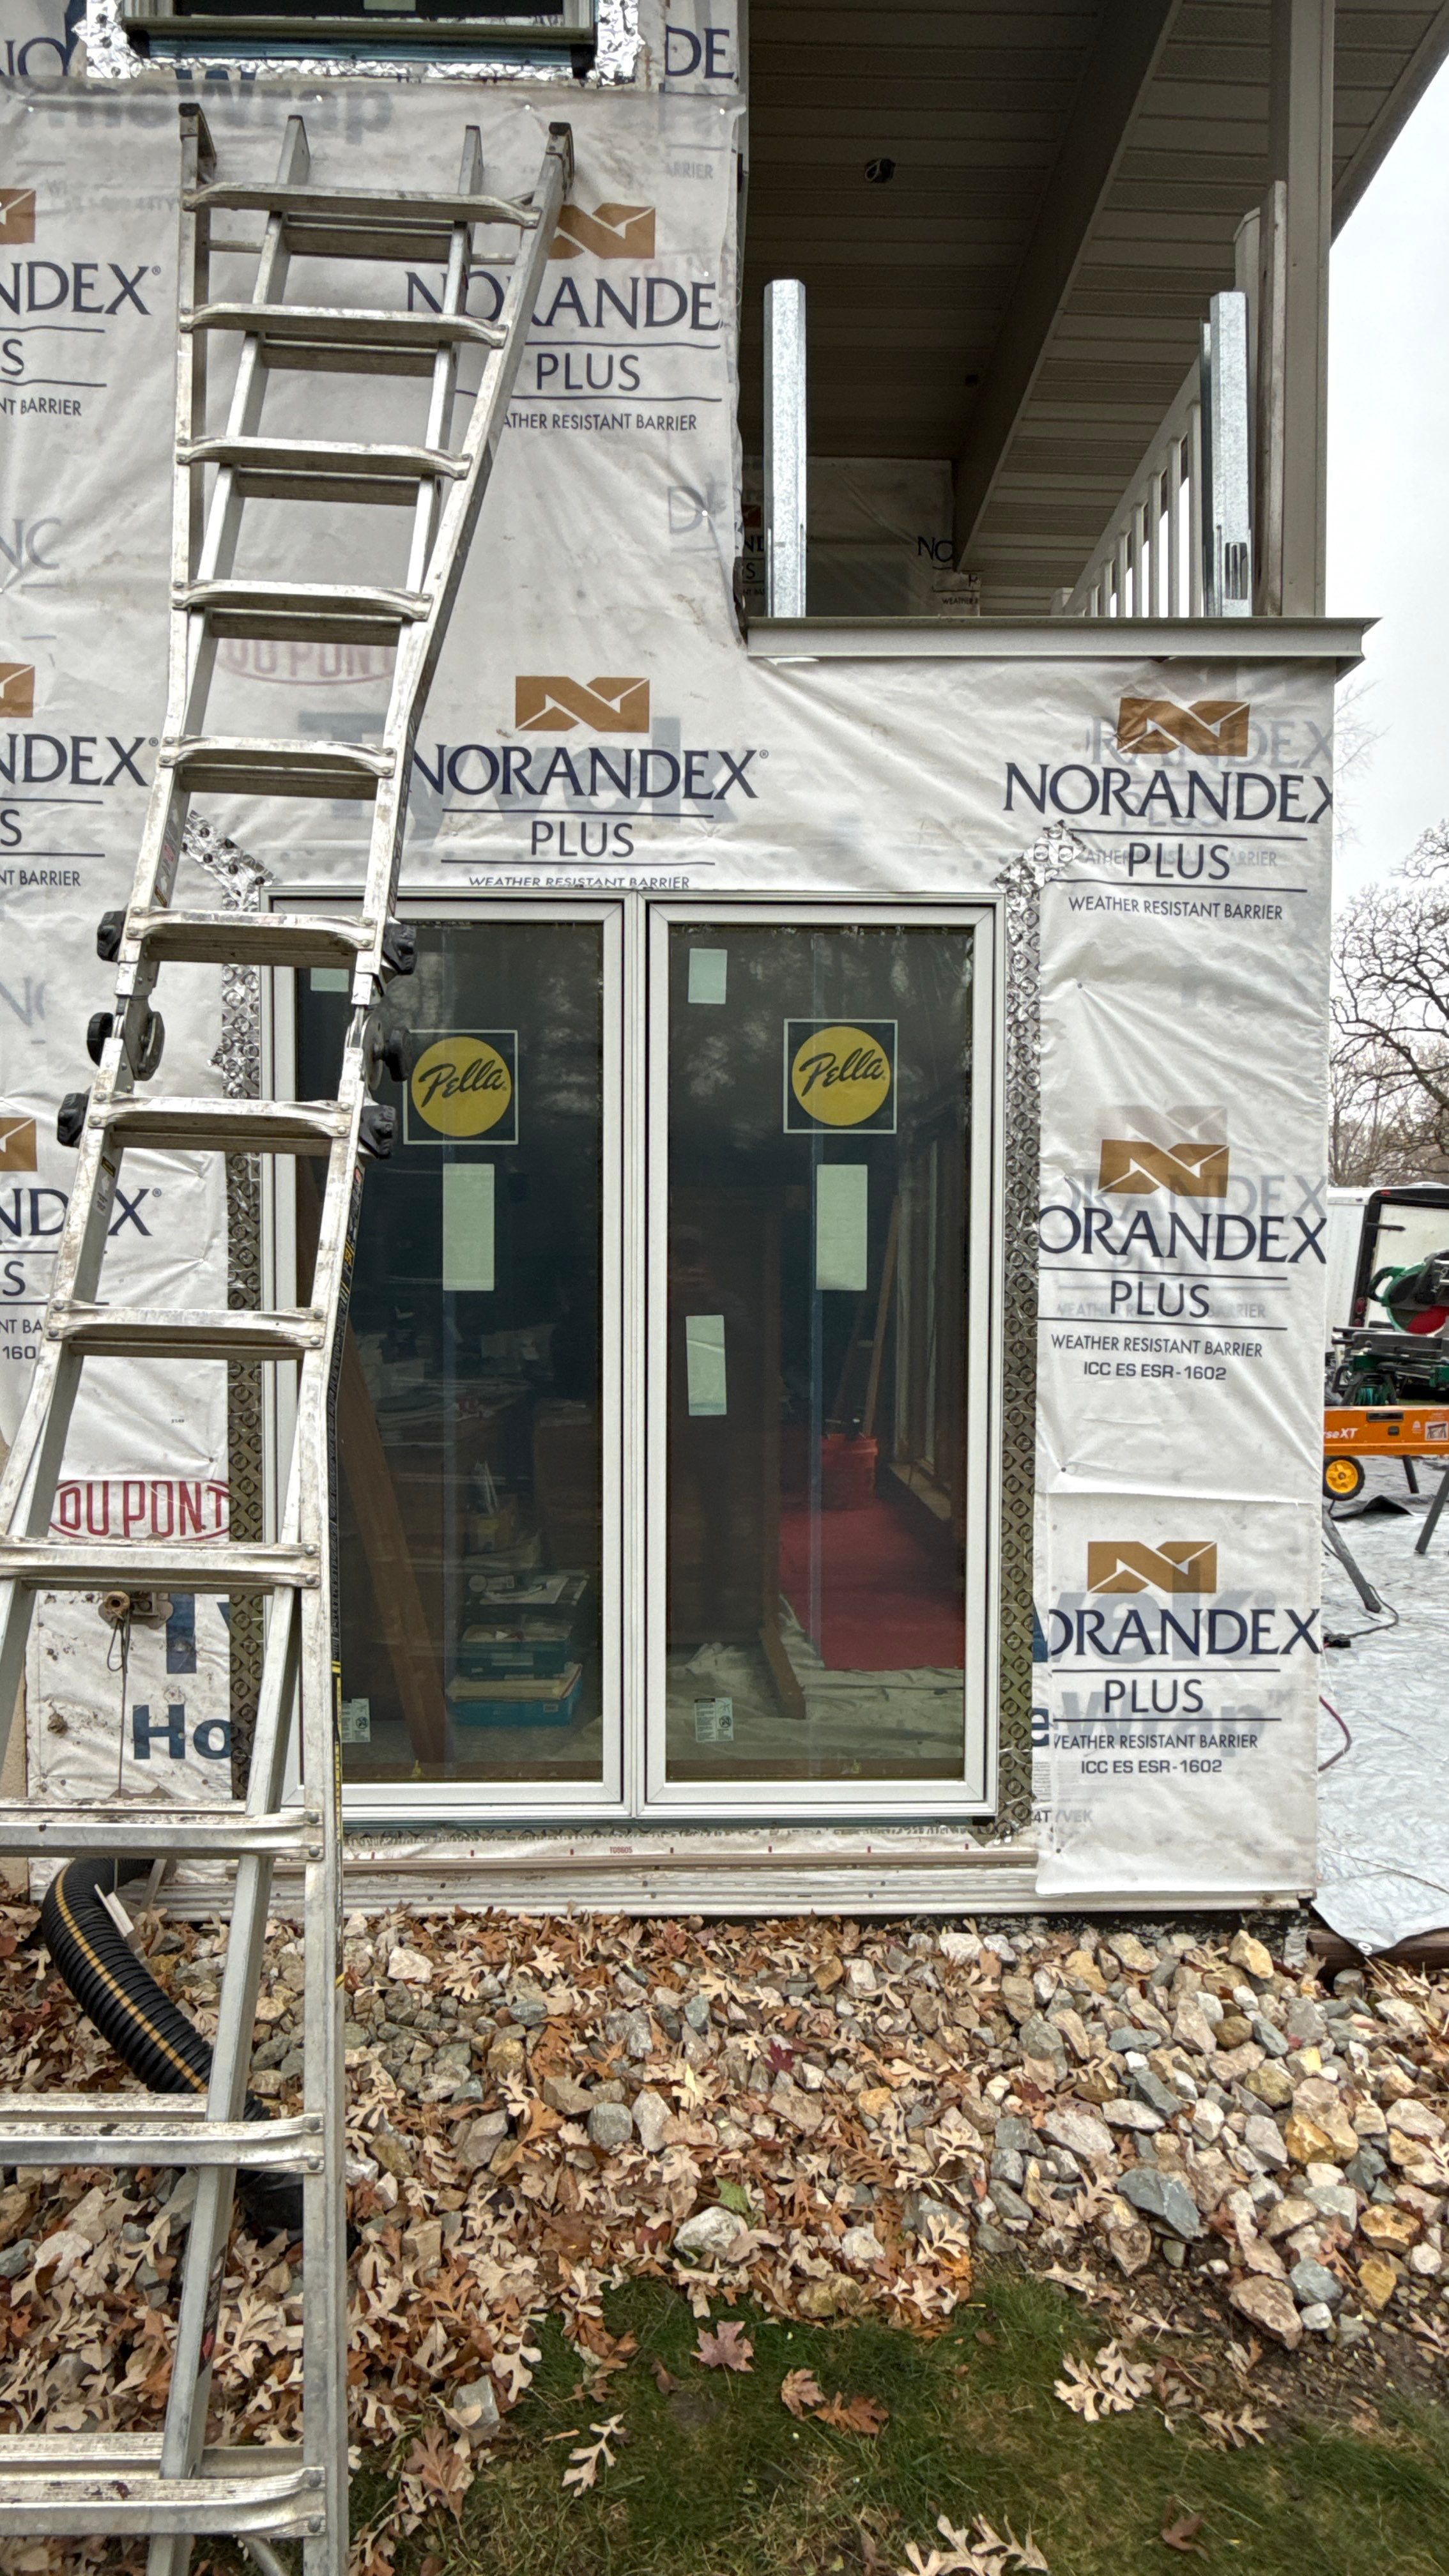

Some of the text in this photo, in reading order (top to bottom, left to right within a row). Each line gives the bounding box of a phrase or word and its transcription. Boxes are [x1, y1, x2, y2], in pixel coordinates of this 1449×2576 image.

[537, 353, 640, 391] PLUS
[20, 397, 82, 416] BARRIER
[503, 413, 697, 431] ATHER RESISTANT BARRIER
[531, 820, 634, 857] PLUS
[1128, 843, 1230, 880] PLUS
[20, 870, 81, 886] BARRIER
[470, 876, 689, 889] WEATHER RESISTANT BARRIER
[1068, 896, 1283, 920] WEATHER RESISTANT BARRIER
[799, 1046, 885, 1095] Pella
[418, 1058, 506, 1108] Pella
[1110, 1280, 1210, 1318] PLUS
[1052, 1333, 1263, 1358] WEATHER RESISTANT BARRIER
[1084, 1361, 1111, 1376] ICC
[1116, 1363, 1137, 1377] ES
[1104, 1678, 1204, 1714] PLUS
[1120, 1733, 1196, 1749] RESISTANT
[1200, 1733, 1258, 1749] BARRIER
[1081, 1760, 1108, 1774] ICC
[1113, 1761, 1133, 1774] ES
